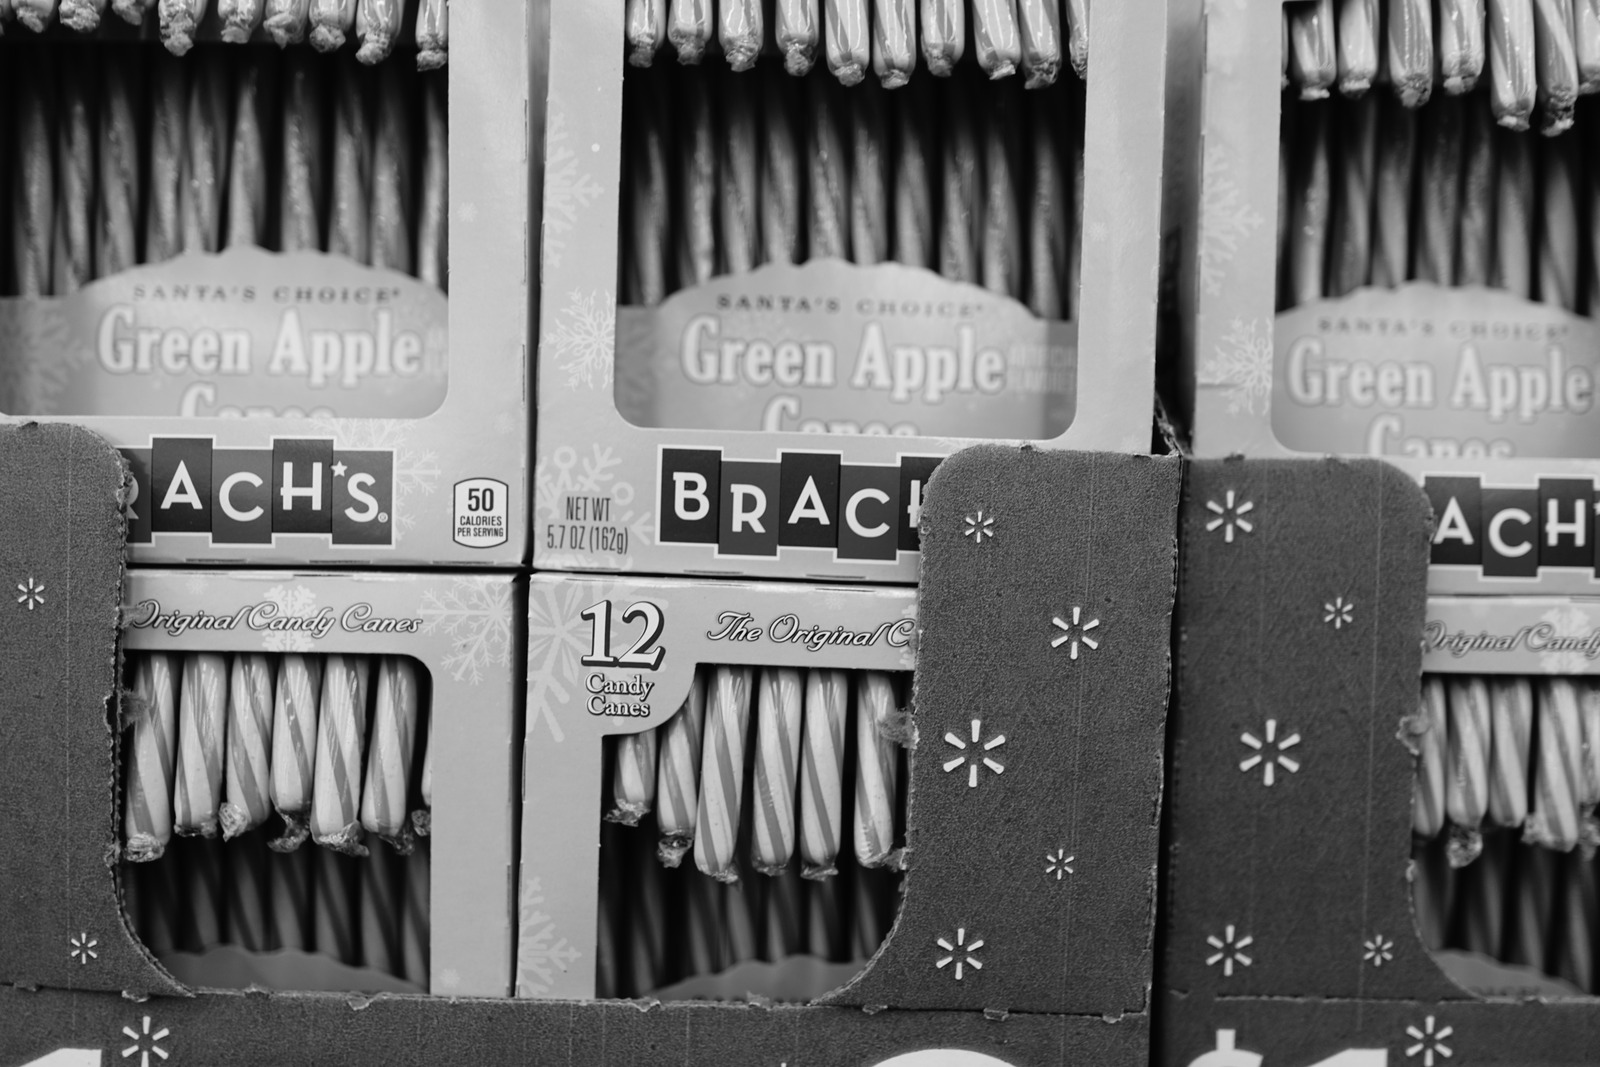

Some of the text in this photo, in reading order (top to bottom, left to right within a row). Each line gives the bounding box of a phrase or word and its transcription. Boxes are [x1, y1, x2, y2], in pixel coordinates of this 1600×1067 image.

[133, 284, 257, 301] SANTA'S
[716, 294, 841, 315] SANTA'S
[99, 304, 252, 376] Green
[268, 305, 422, 388] Apple
[682, 314, 836, 386] Green
[851, 321, 1004, 402] Apple
[1289, 336, 1593, 422] Green Apple
[467, 487, 495, 512] 50
[566, 496, 611, 522] NET WT
[457, 527, 504, 538] PER SERVING
[459, 515, 503, 527] CALORIES
[547, 525, 629, 555] 5.7 OZ (162g)
[247, 600, 336, 639] Candy
[340, 602, 423, 634] Canes
[707, 610, 763, 642] The
[769, 613, 893, 652] Original
[581, 599, 667, 671] 12
[585, 672, 656, 700] Candy
[586, 694, 651, 718] Canes
